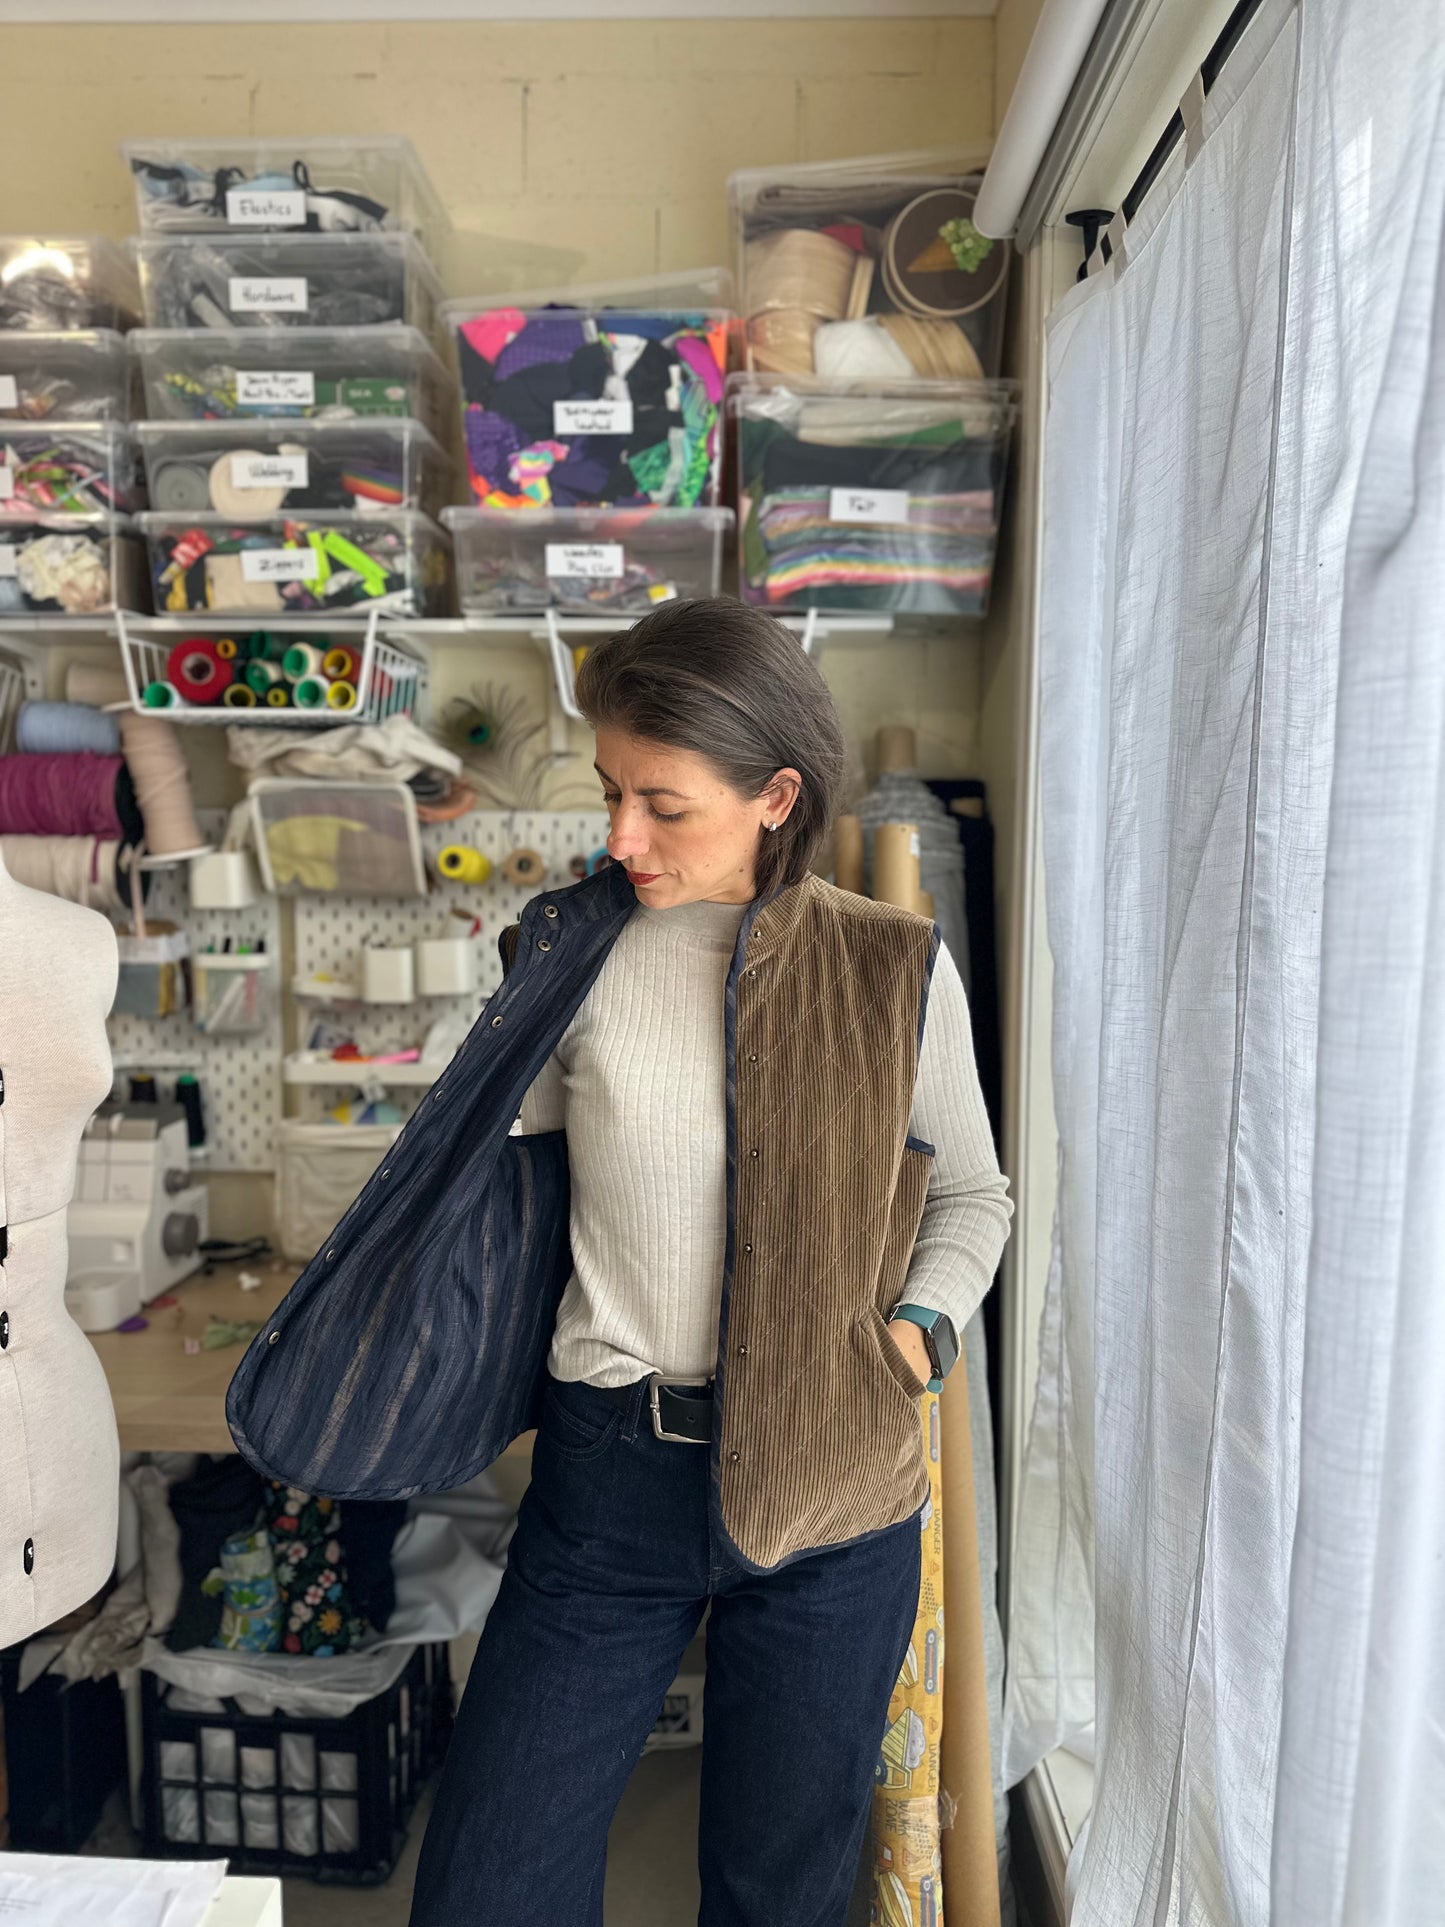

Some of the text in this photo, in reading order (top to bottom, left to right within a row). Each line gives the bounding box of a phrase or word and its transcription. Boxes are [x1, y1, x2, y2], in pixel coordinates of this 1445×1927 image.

[240, 199, 291, 217] Elastics
[242, 286, 295, 303] Hardware
[933, 1508, 941, 1555] DANGER
[928, 1743, 937, 1793] DANGER
[885, 1798, 898, 1833] ZONE
[898, 1800, 910, 1837] WORK
